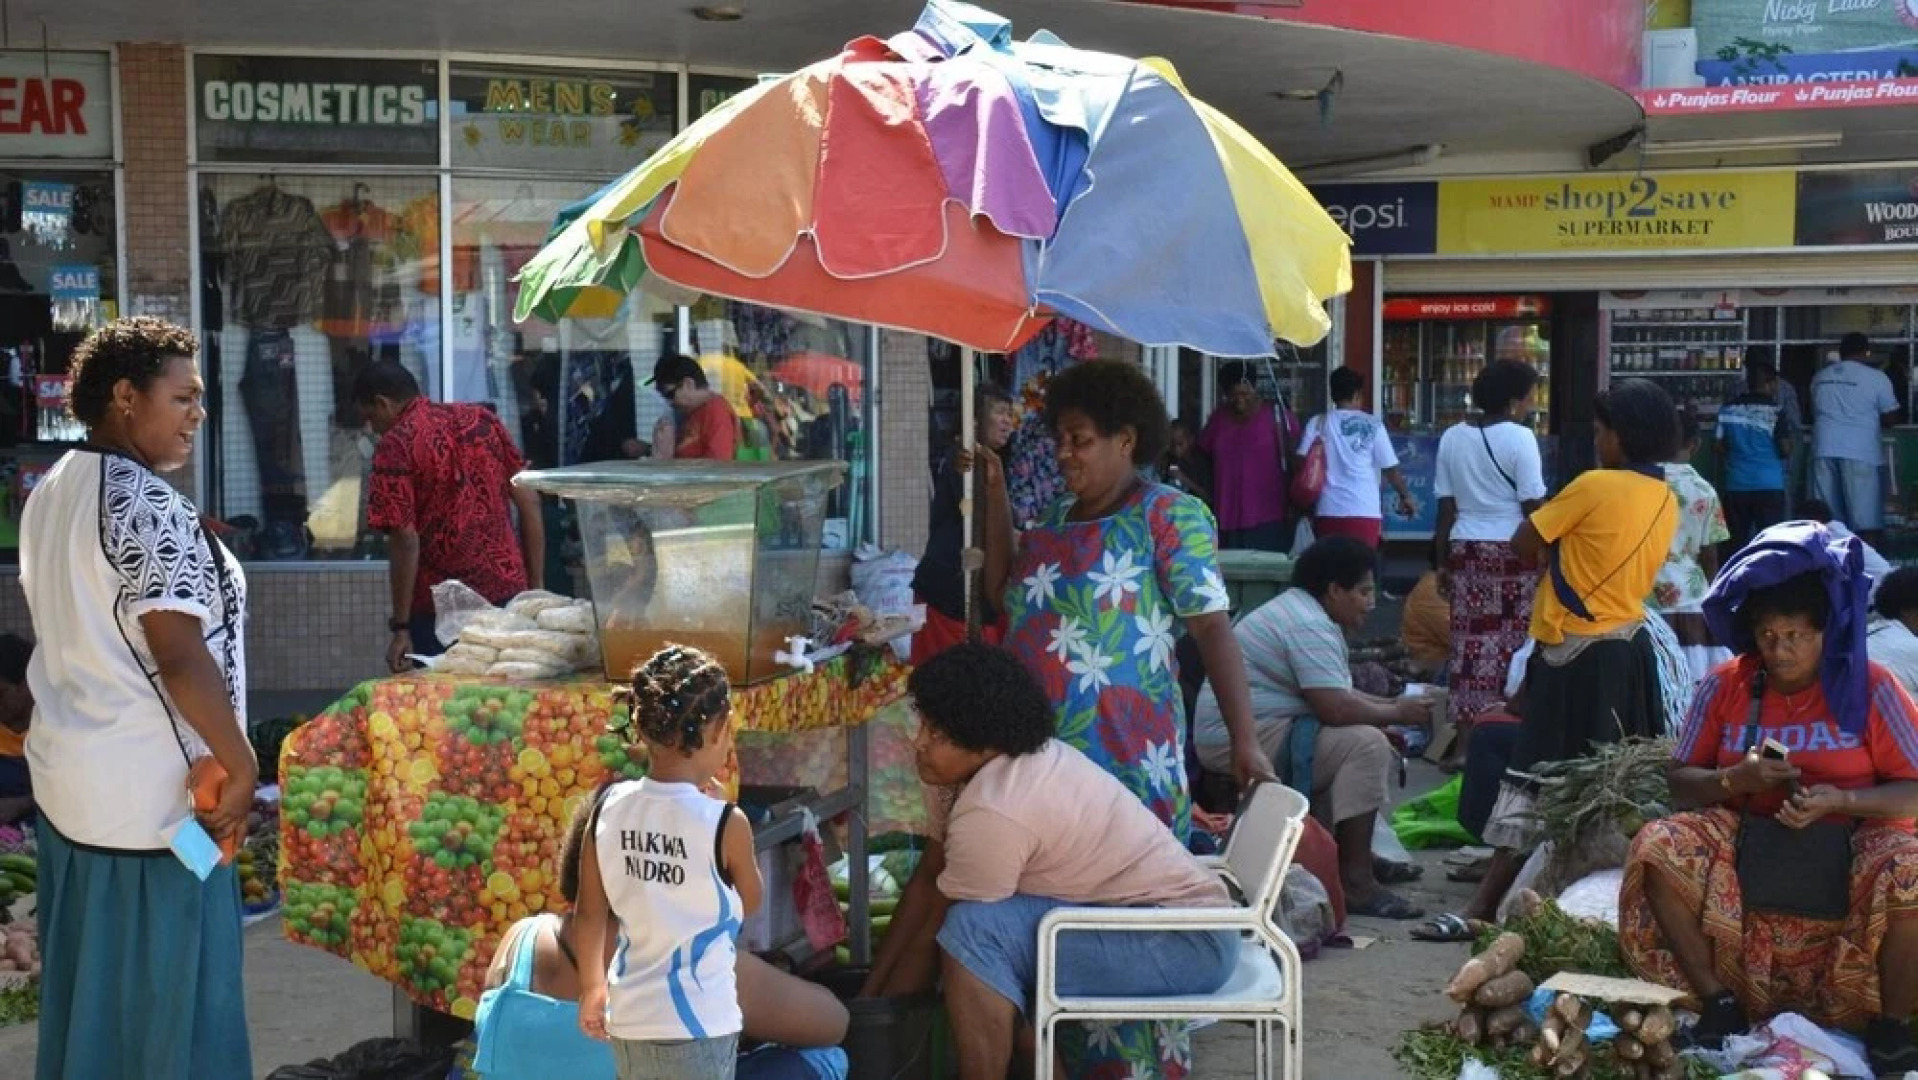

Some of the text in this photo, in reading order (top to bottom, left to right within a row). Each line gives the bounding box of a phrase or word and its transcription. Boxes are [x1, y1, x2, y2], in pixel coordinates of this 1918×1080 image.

[1763, 0, 1816, 24] Nicky
[204, 80, 424, 124] COSMETICS
[485, 78, 615, 116] MENS
[1669, 89, 1783, 110] Punjas Flour
[1810, 83, 1873, 103] Punjas
[501, 117, 591, 147] WEAR
[26, 188, 73, 207] SALE
[1864, 202, 1918, 224] WOOD
[1558, 219, 1713, 236] SUPERMARKET
[53, 273, 97, 290] SALE
[1420, 300, 1496, 315] enjoy ice cold
[620, 829, 688, 859] HAKWA
[624, 855, 686, 885] NADRO
